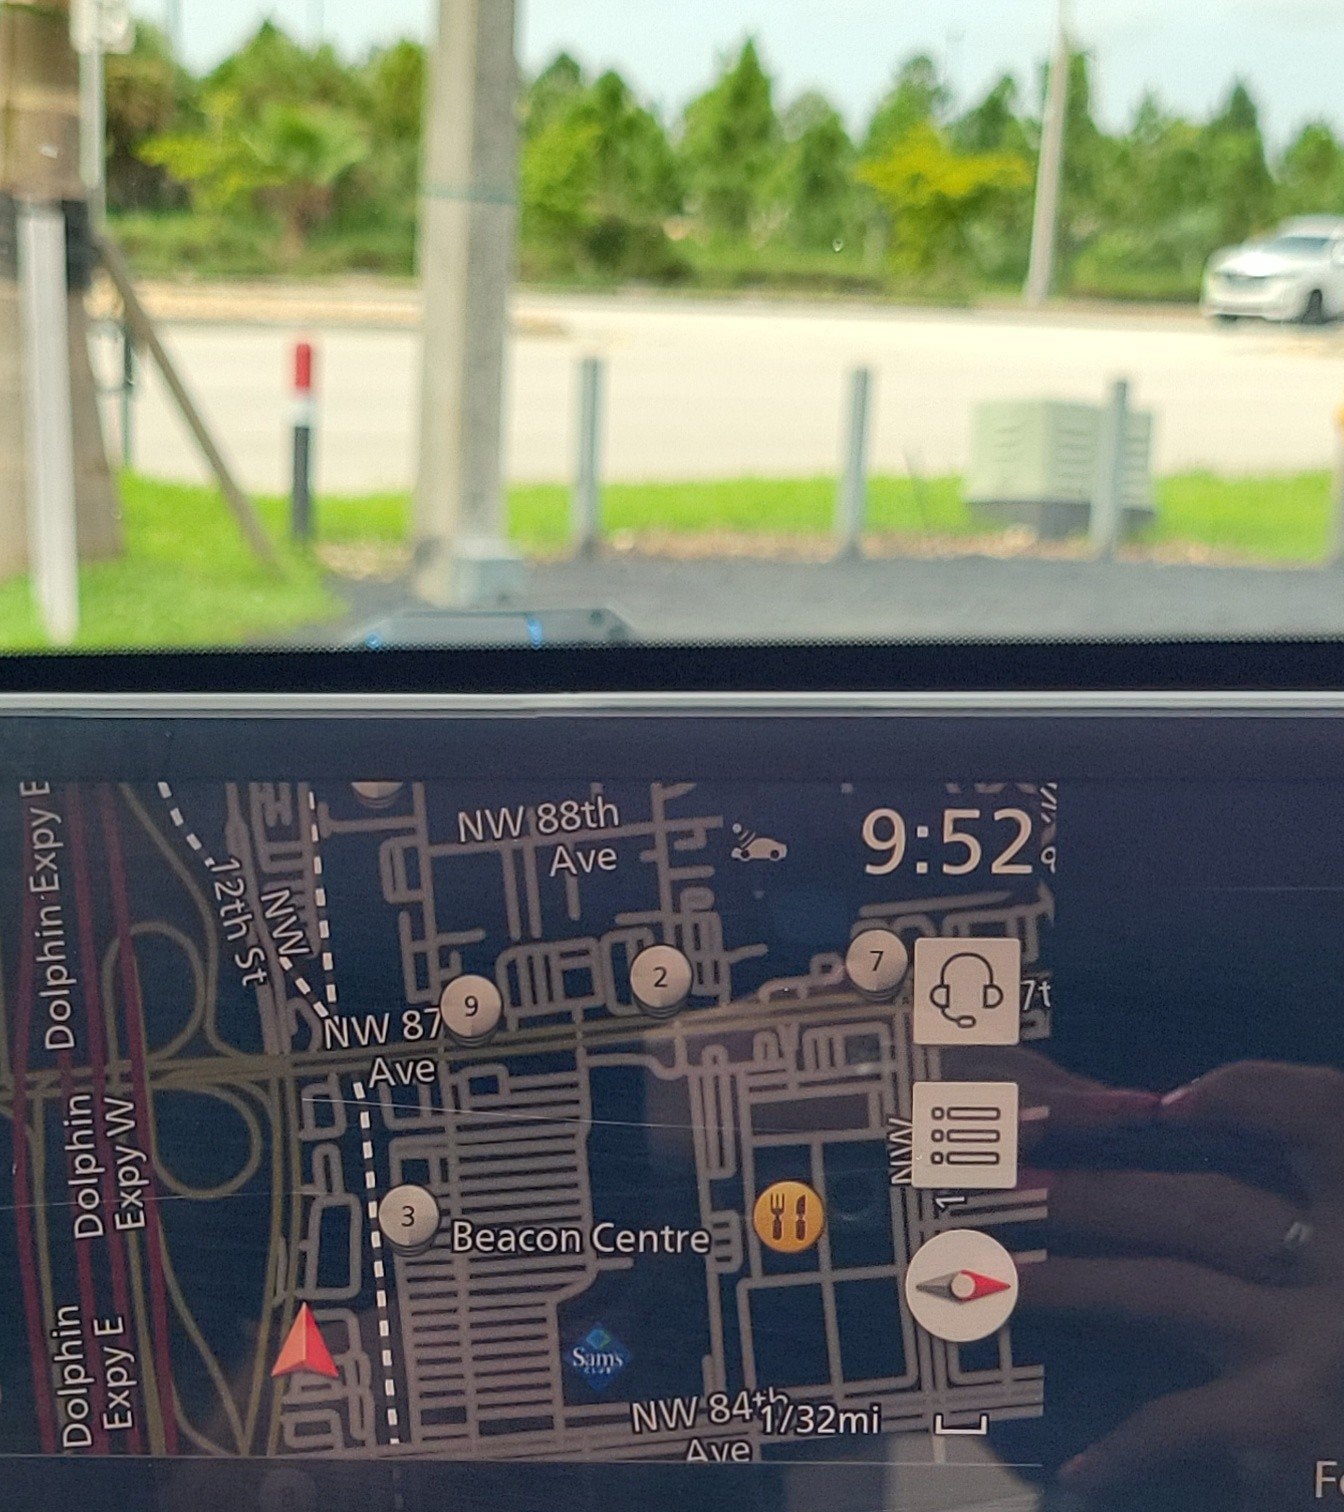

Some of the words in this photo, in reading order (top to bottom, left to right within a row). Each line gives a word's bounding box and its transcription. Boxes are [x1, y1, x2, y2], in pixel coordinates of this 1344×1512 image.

[457, 804, 525, 844] NW
[536, 796, 621, 835] 88th
[860, 808, 1034, 876] 9:52
[28, 806, 64, 893] Expy
[548, 847, 619, 878] Ave
[207, 857, 255, 940] 12th
[233, 946, 269, 987] St
[259, 888, 311, 957] NW
[36, 905, 76, 1051] Dolphin
[322, 1011, 391, 1050] NW
[401, 1007, 441, 1043] 87
[367, 1056, 438, 1089] Ave
[103, 1096, 137, 1140] W
[64, 1091, 104, 1239] Dolphin
[113, 1143, 148, 1231] Expy
[452, 1221, 582, 1254] Beacon
[591, 1223, 711, 1256] Centre
[93, 1316, 125, 1337] E
[53, 1304, 93, 1448] Dolphin
[102, 1348, 137, 1432] Expy
[632, 1396, 698, 1433] NW
[760, 1404, 880, 1434] 1/32mi
[686, 1439, 750, 1462] Ave
